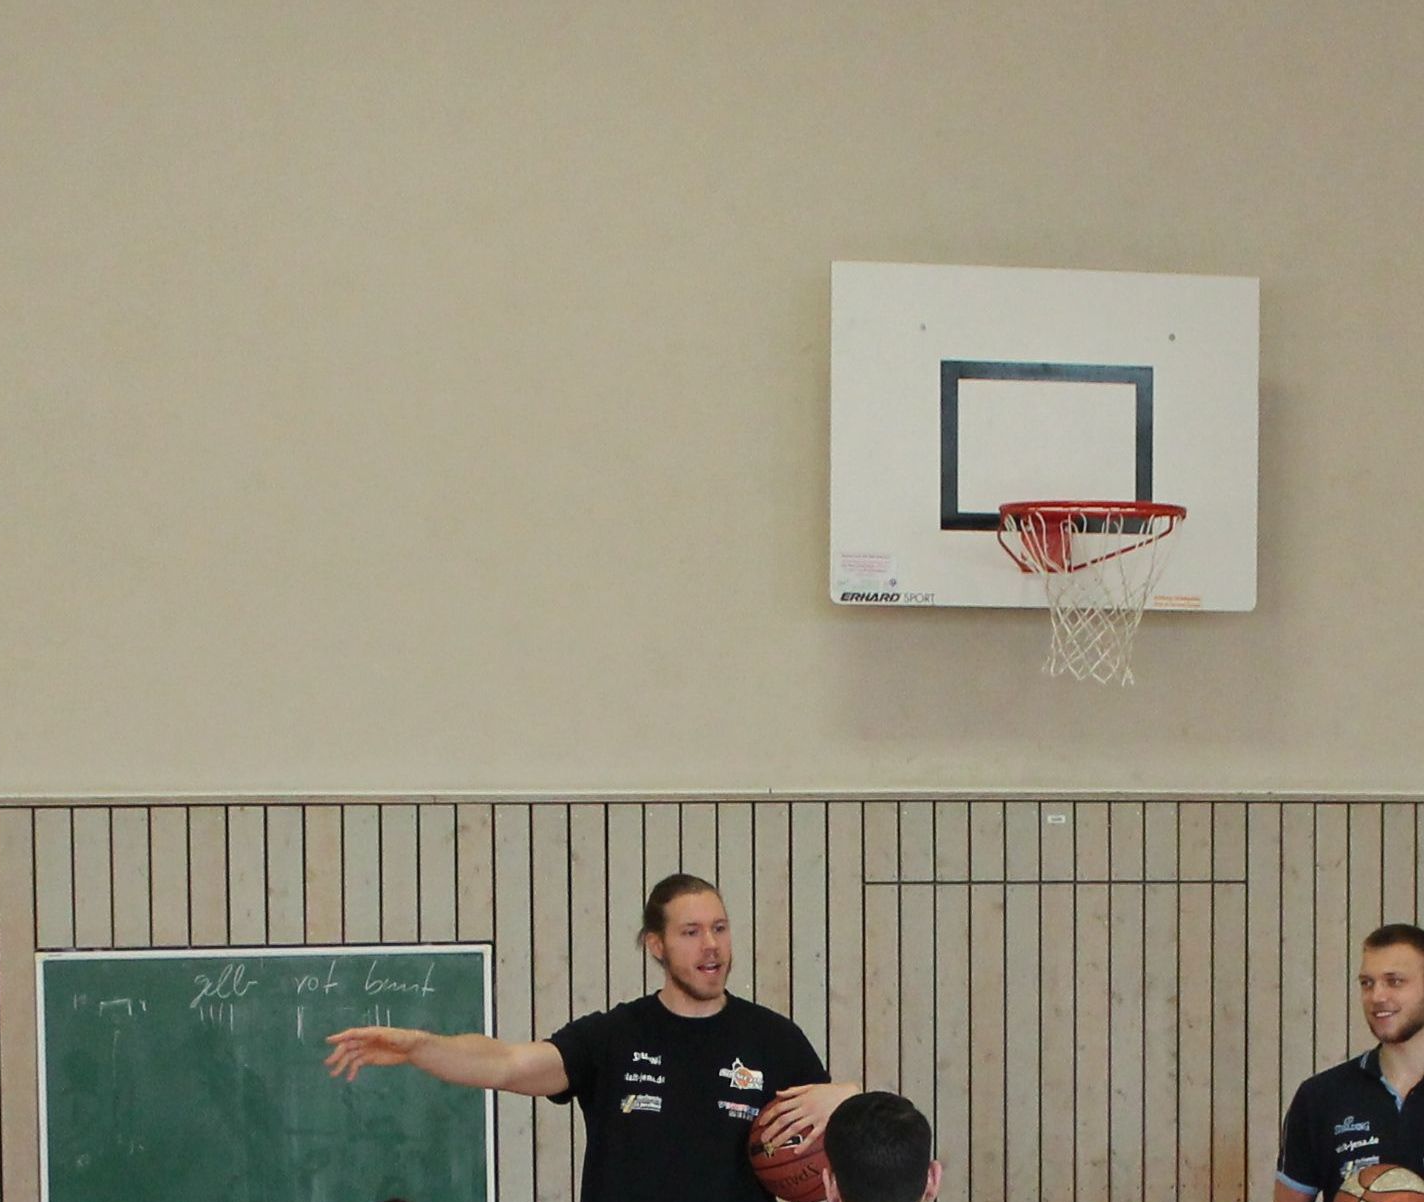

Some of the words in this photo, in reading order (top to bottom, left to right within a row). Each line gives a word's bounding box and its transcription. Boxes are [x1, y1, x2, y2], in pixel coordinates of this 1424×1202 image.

[840, 592, 901, 602] ERHARD
[904, 592, 936, 603] SPORT
[293, 960, 339, 995] rot
[364, 959, 436, 998] bunt
